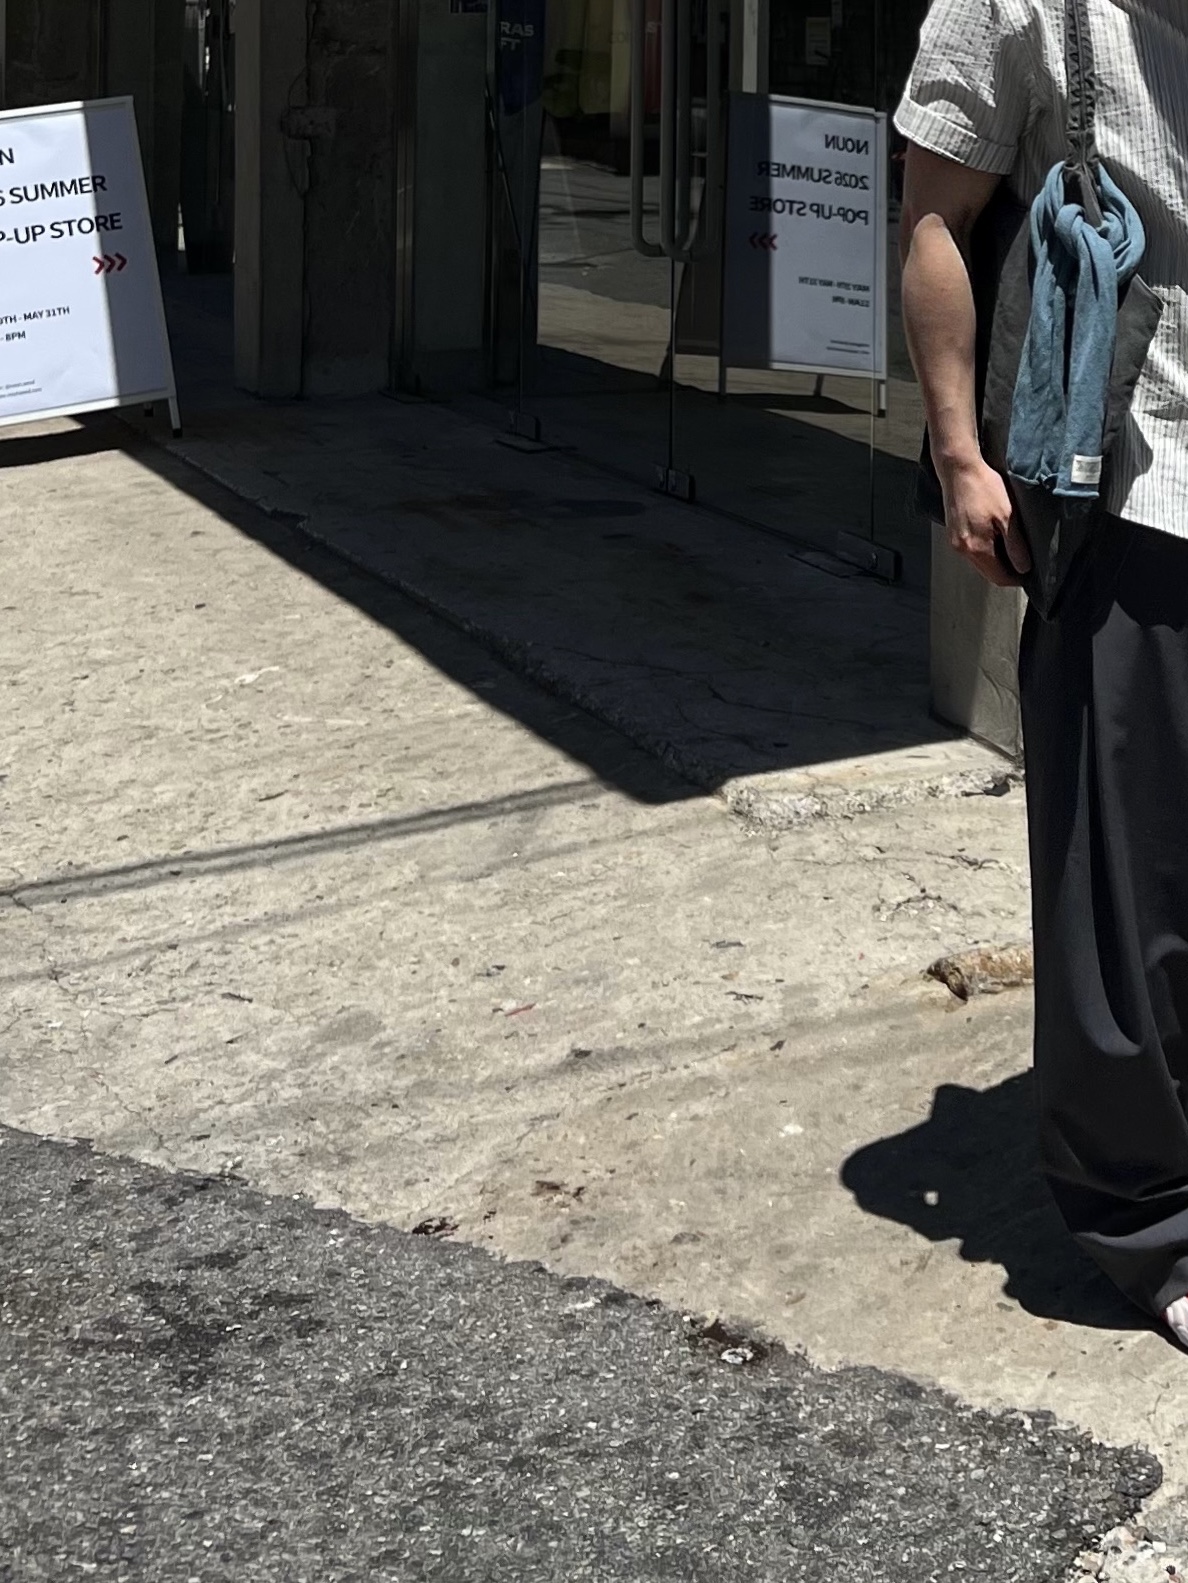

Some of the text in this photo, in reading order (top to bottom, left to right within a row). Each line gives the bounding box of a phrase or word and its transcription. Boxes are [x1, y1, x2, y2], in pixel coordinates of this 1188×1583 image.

[9, 175, 107, 204] SUMMER
[50, 212, 122, 239] STORE
[23, 312, 43, 321] MAY
